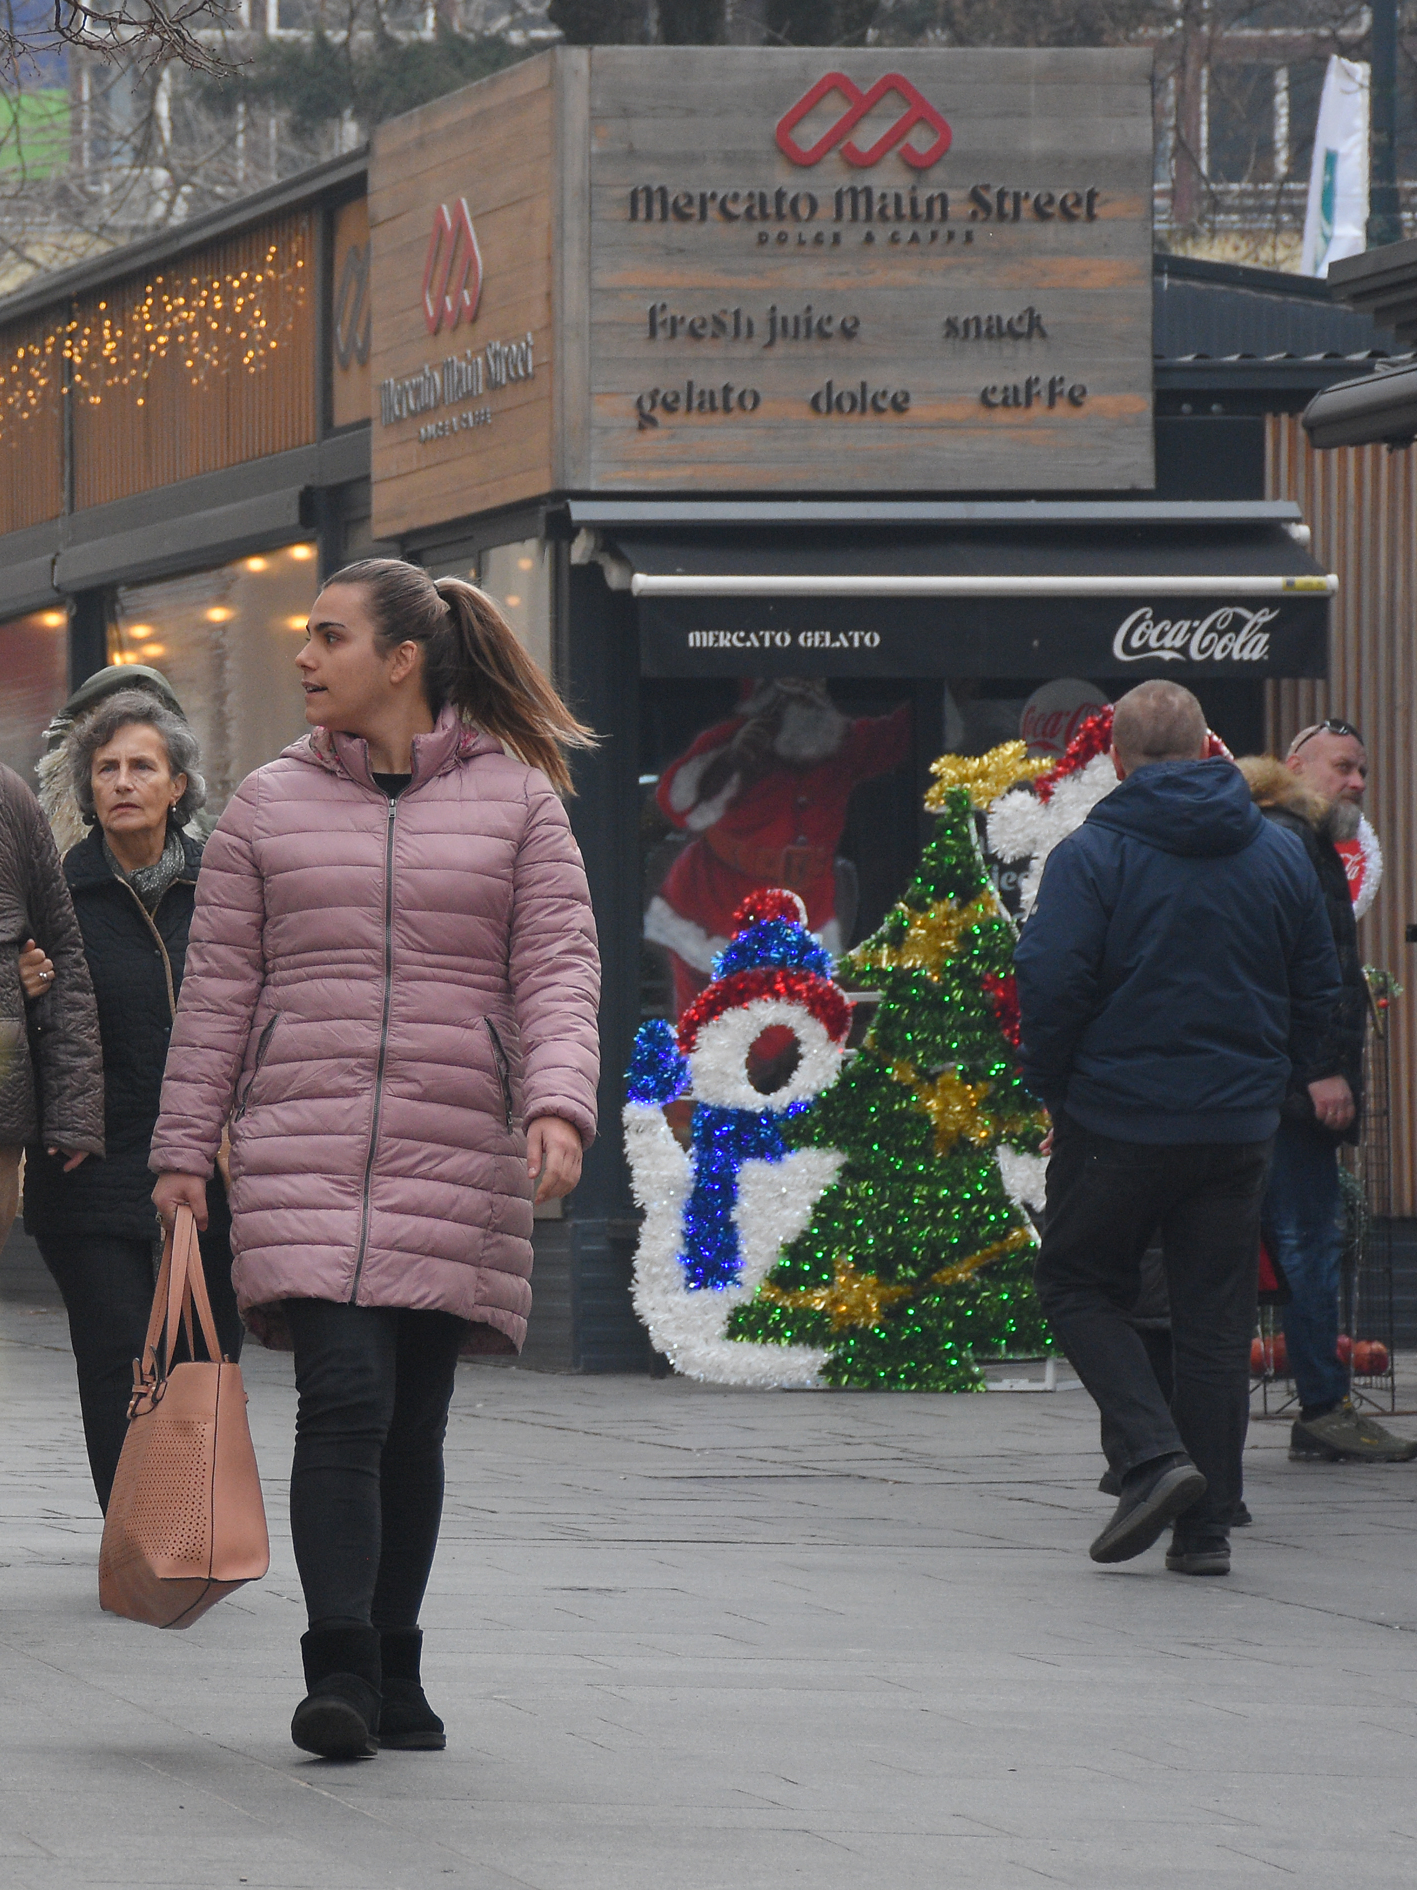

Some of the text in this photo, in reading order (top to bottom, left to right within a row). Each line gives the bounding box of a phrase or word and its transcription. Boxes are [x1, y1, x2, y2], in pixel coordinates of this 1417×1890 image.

[629, 184, 1099, 222] Mercato Main Street
[757, 230, 842, 246] DOLCE
[889, 229, 975, 244] CAFFE
[762, 304, 861, 349] juice
[943, 305, 1048, 340] snack
[635, 380, 761, 430] gelato
[809, 379, 911, 414] dolce
[980, 375, 1088, 409] caffe
[688, 630, 881, 648] MERCATO GELATO
[1112, 606, 1281, 662] Coca-Cola
